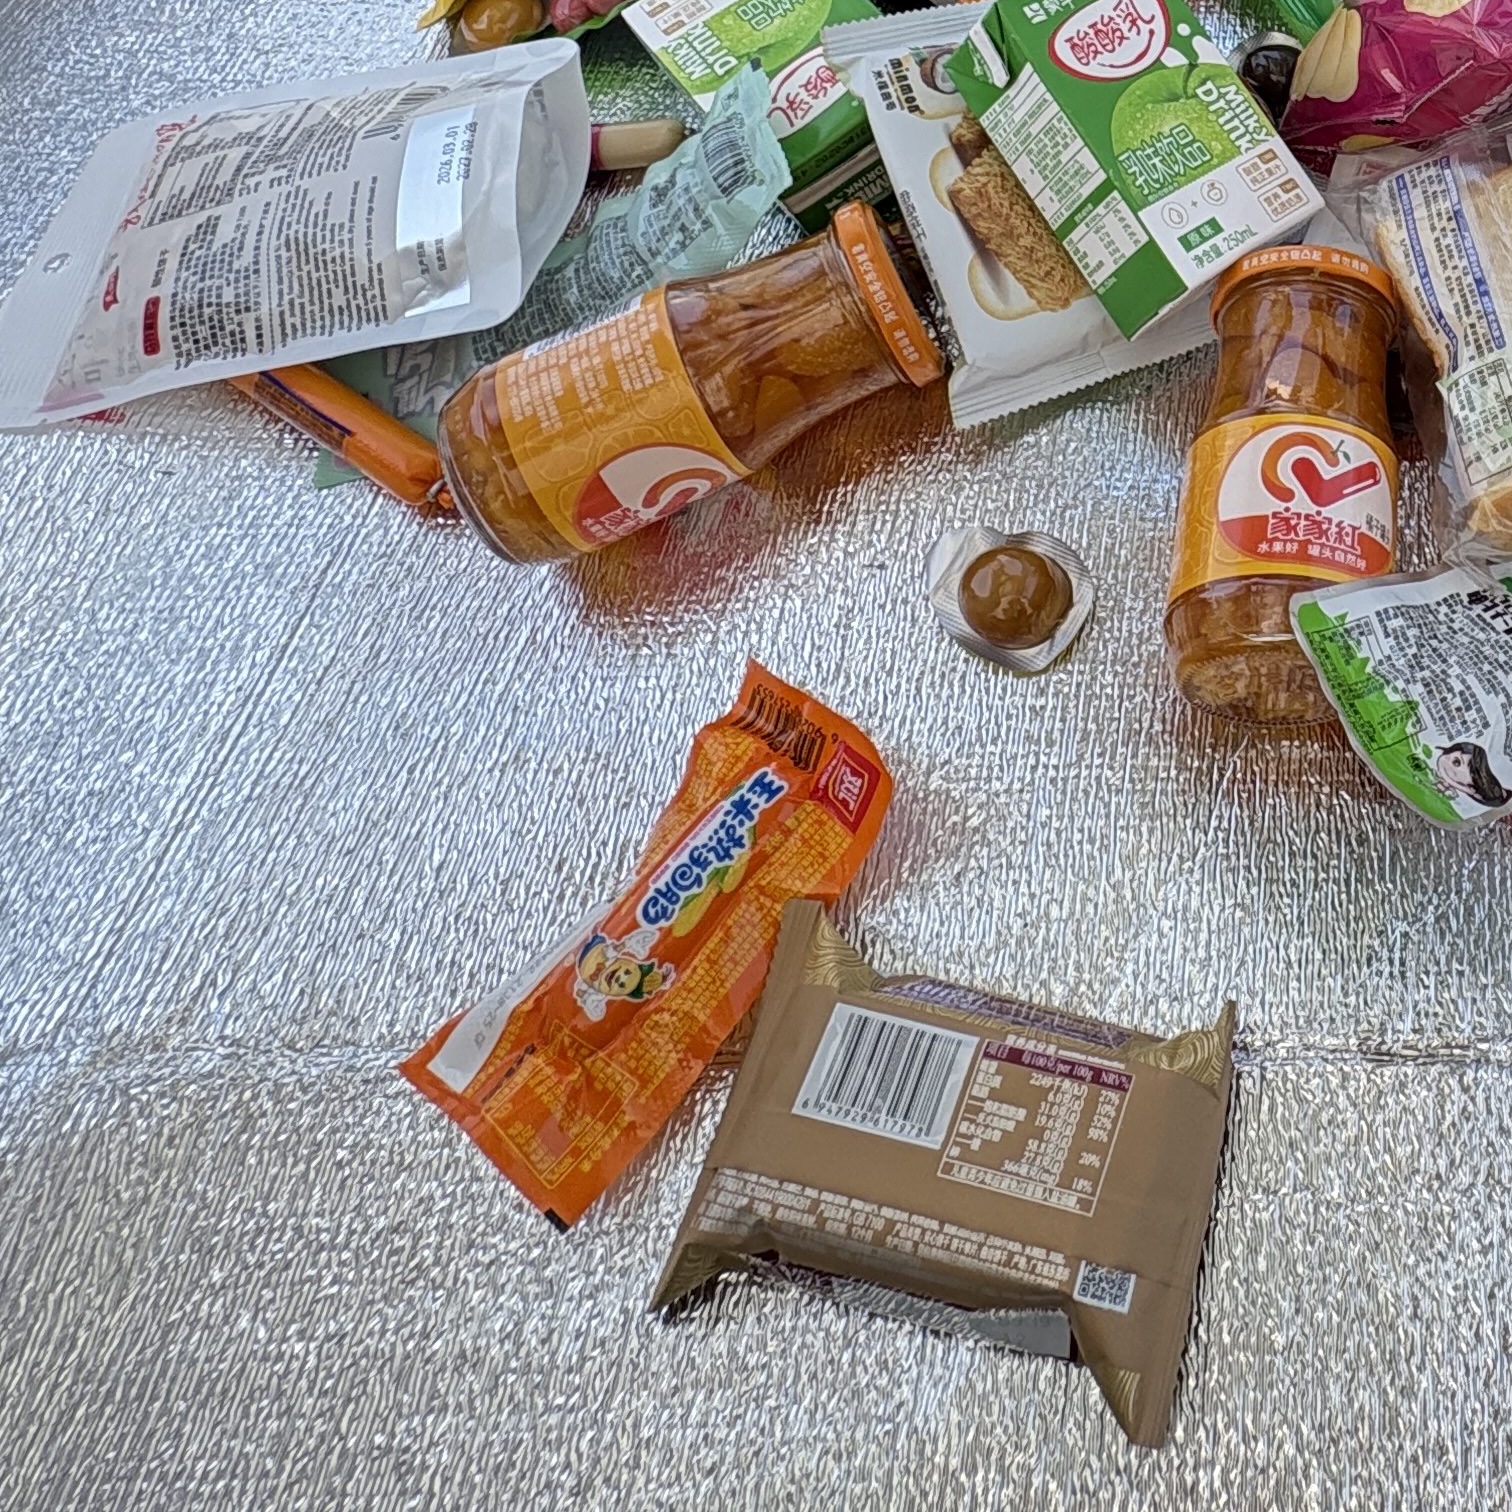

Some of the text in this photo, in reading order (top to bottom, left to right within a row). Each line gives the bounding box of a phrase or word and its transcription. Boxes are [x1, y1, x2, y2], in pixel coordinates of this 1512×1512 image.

[888, 58, 923, 115] minmon
[1220, 82, 1276, 146] Milky
[1118, 124, 1212, 196] 乳味饮品
[1186, 222, 1216, 246] 原味
[1256, 540, 1300, 556] 水果好
[640, 767, 789, 928] 玉米热狗肠
[1071, 1063, 1095, 1083] 100g
[1099, 1071, 1130, 1090] NRV%
[816, 1100, 869, 1125] 947929
